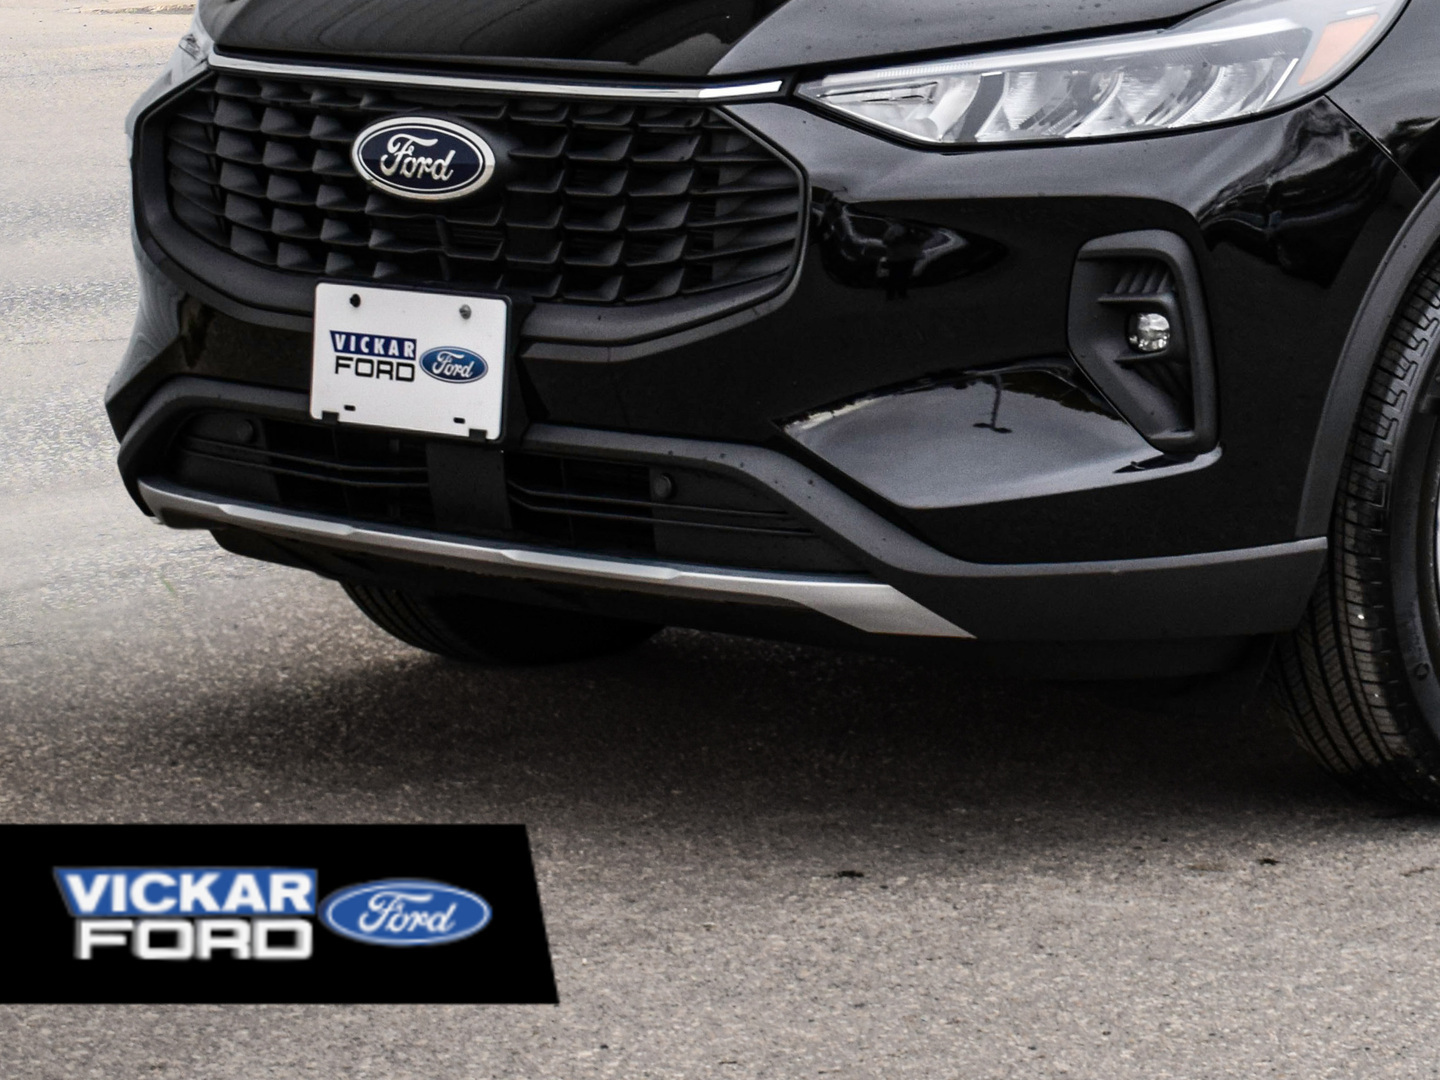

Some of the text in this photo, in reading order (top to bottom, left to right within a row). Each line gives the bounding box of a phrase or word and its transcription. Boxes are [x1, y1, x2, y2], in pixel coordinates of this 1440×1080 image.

[379, 133, 457, 182] Ford
[334, 332, 416, 360] VICKAR
[334, 355, 416, 383] FORD
[431, 351, 474, 379] Ford
